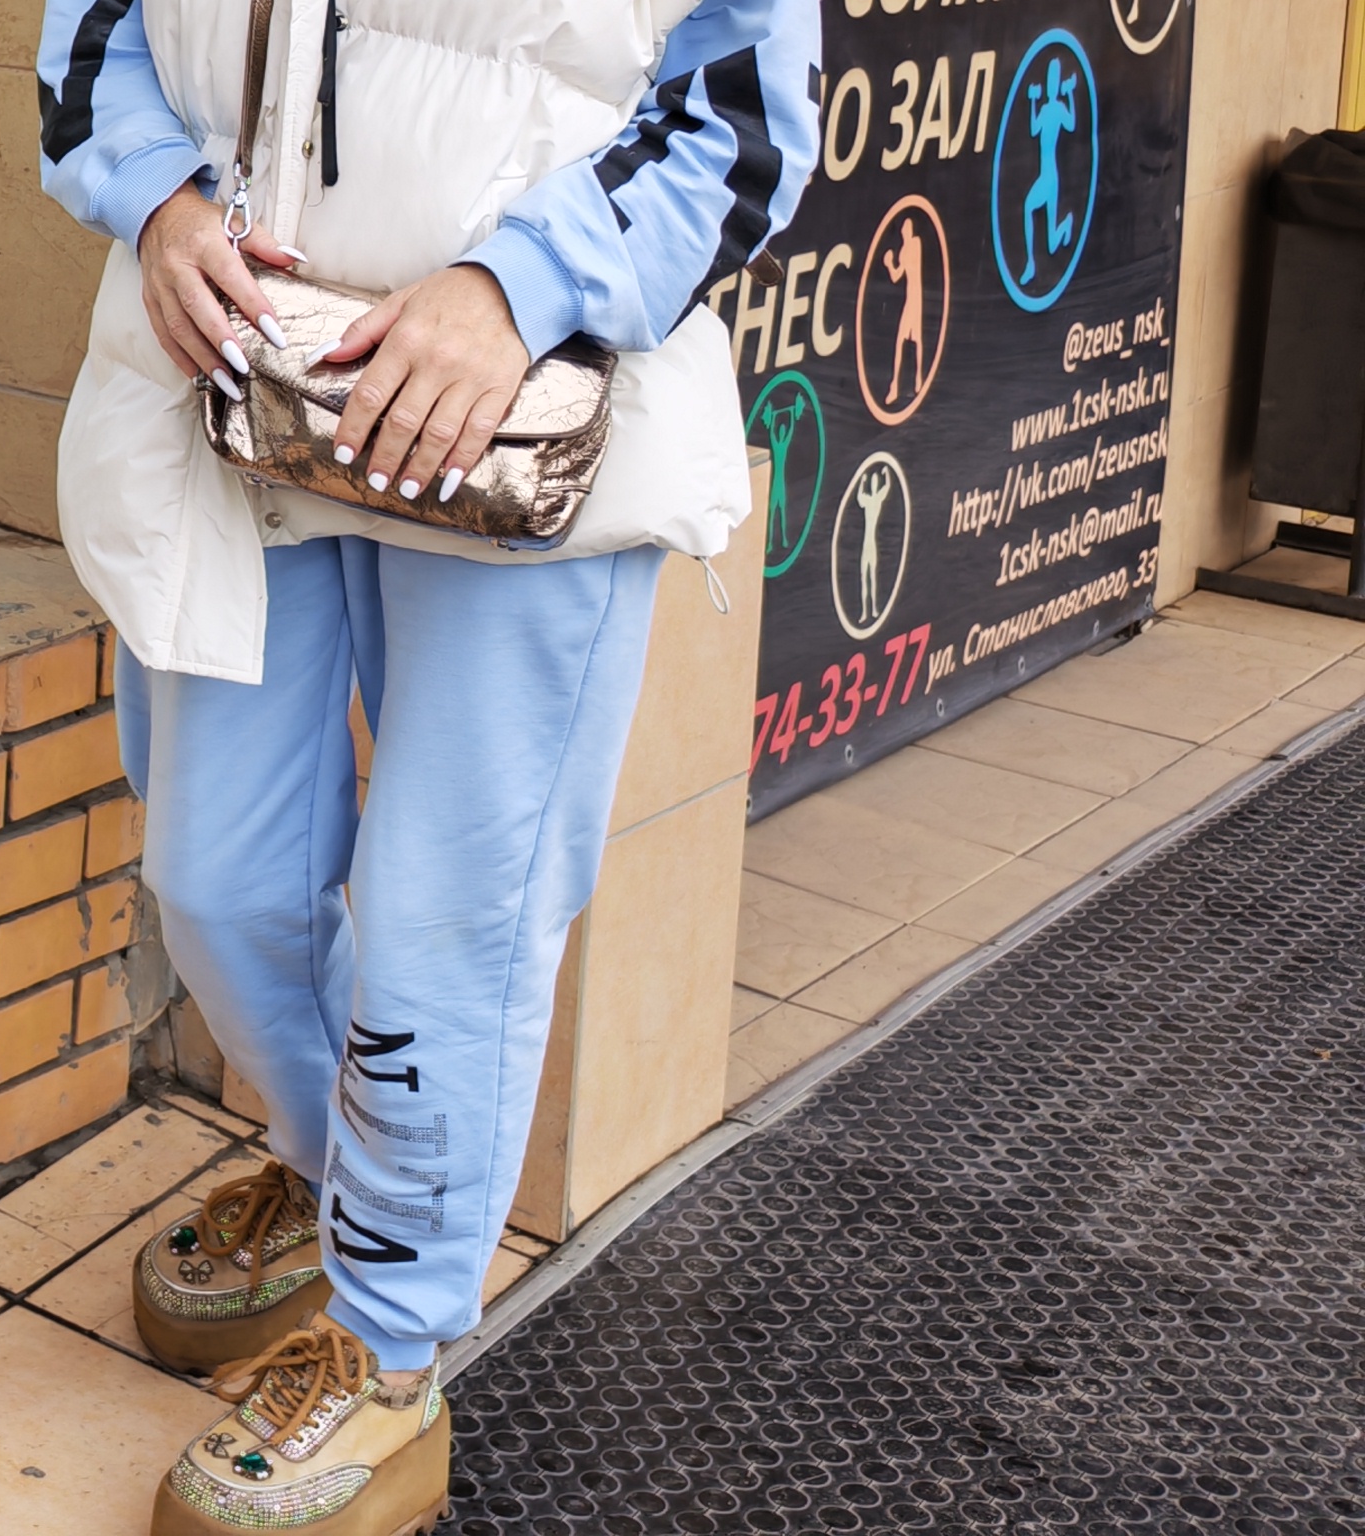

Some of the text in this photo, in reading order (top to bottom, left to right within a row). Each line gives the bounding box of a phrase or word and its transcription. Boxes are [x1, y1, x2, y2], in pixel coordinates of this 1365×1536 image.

[881, 50, 996, 171] ЗАЛ
[1063, 296, 1170, 373] @zeus_nsk_
[1011, 366, 1168, 452] www.1csk-nsk.ru
[948, 416, 1167, 538] http://vk.com/zeusnsk
[996, 487, 1163, 587] 1csk-nsk@mail.ru
[925, 546, 1158, 695] ул. Станиславского, 33
